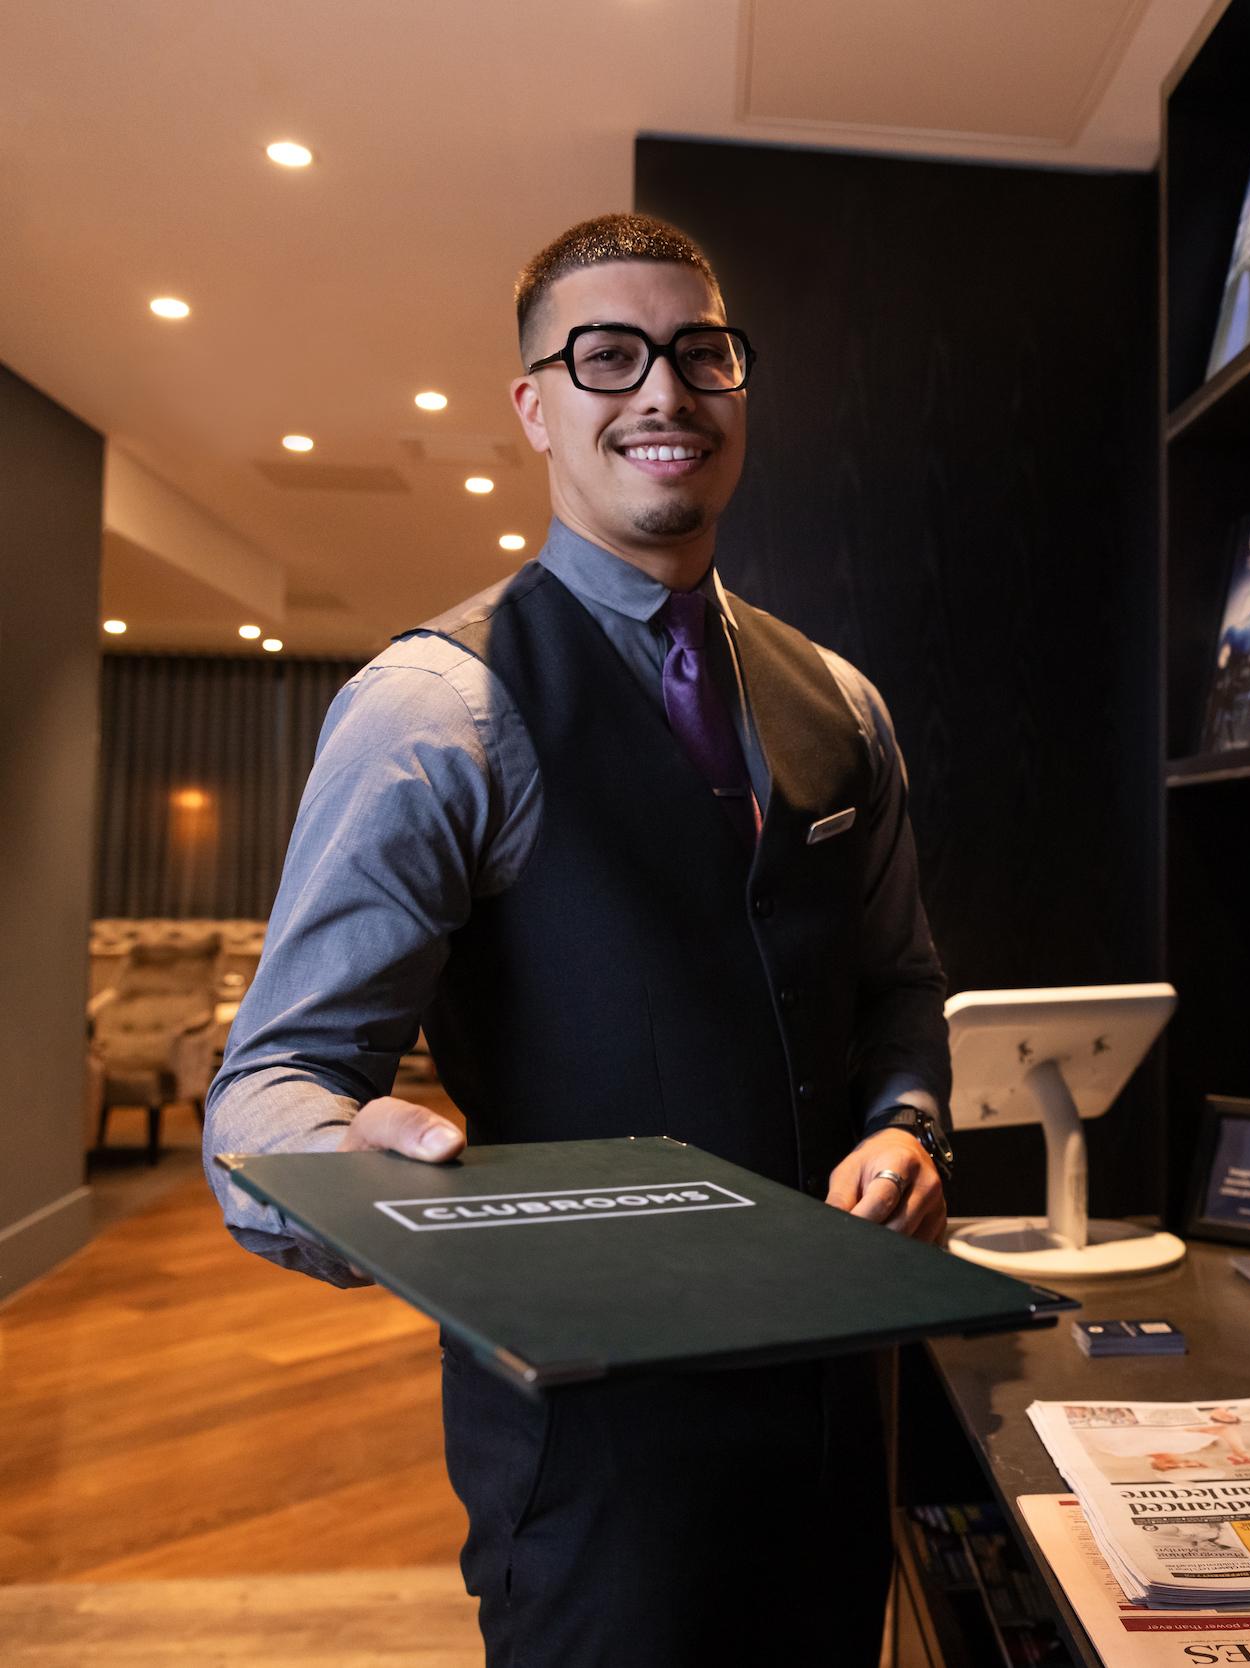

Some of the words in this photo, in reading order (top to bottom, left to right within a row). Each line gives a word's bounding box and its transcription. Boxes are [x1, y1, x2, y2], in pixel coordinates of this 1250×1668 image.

[422, 1190, 711, 1220] CLUBROOMS
[1121, 1488, 1217, 1501] lecture
[1156, 1551, 1245, 1559] Photographing
